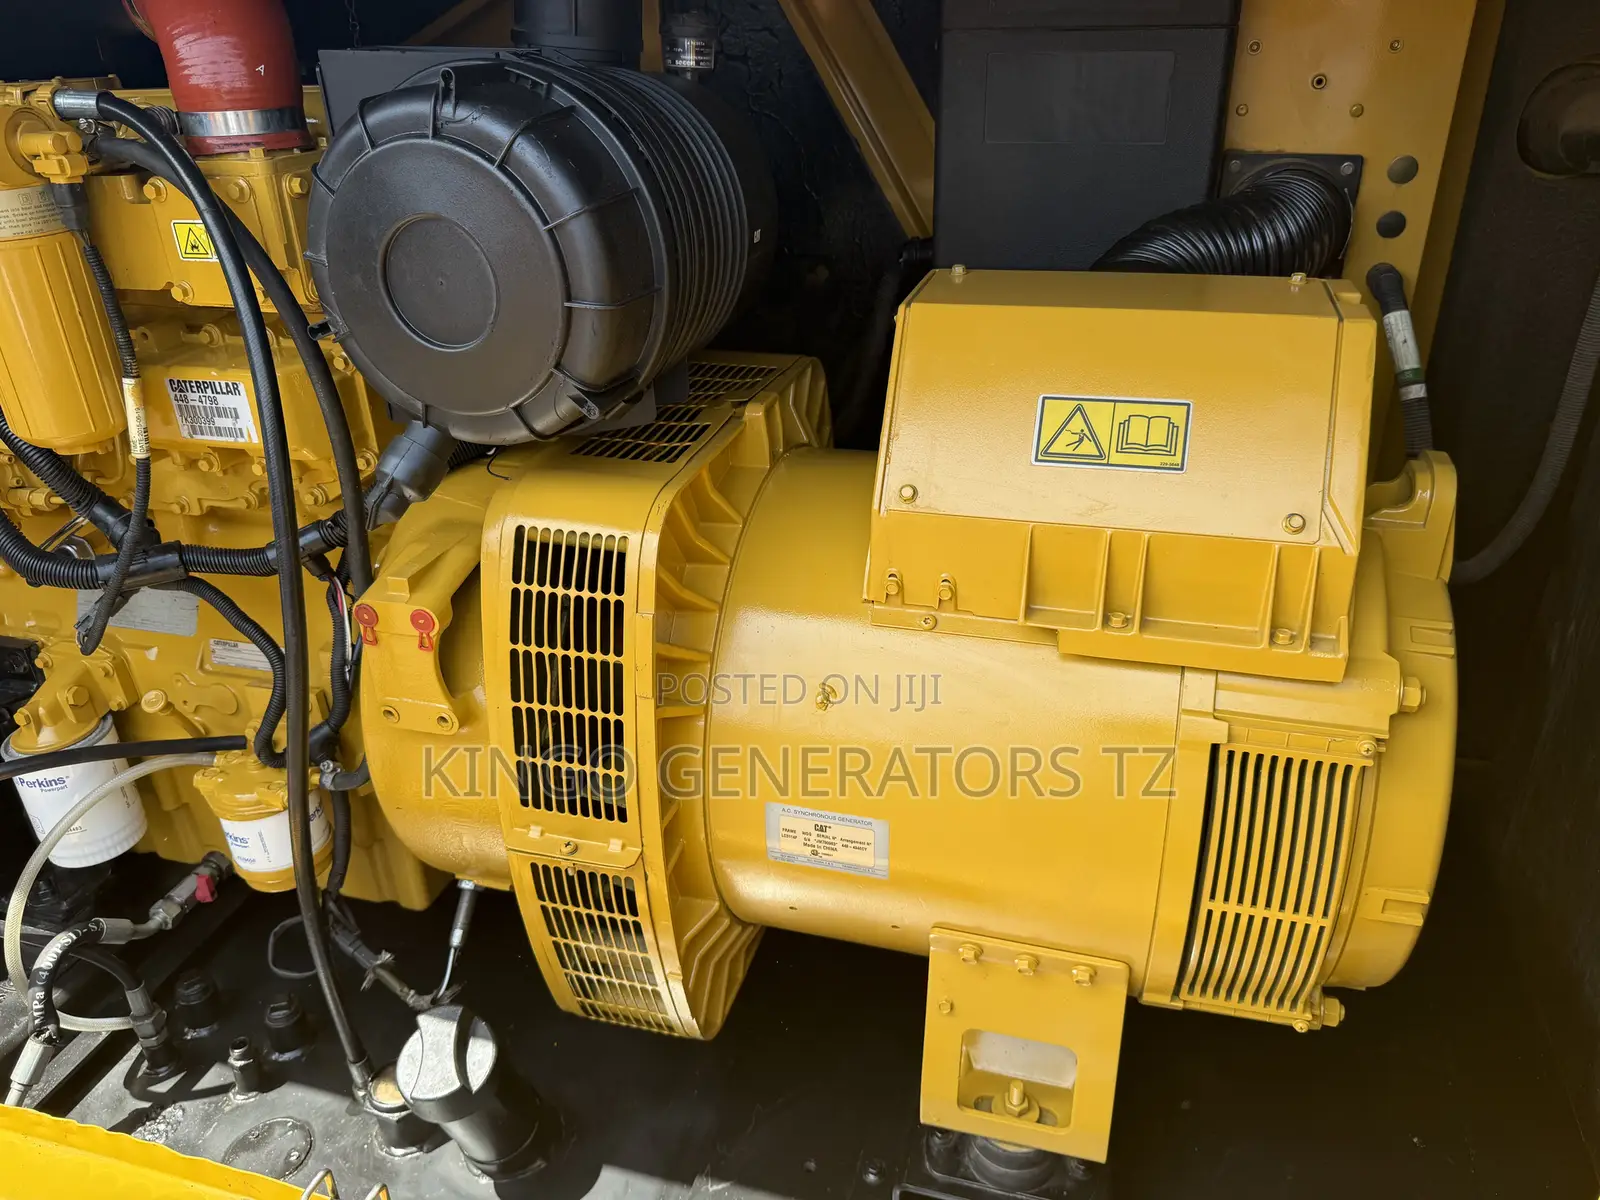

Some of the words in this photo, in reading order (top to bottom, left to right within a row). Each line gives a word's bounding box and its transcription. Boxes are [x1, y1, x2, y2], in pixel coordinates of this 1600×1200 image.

[168, 378, 242, 396] CATERPILLAR
[18, 775, 66, 789] Perkins
[794, 809, 837, 821] SYNCHRONOUS
[838, 816, 873, 826] GENERATOR
[33, 991, 46, 1025] MPa
